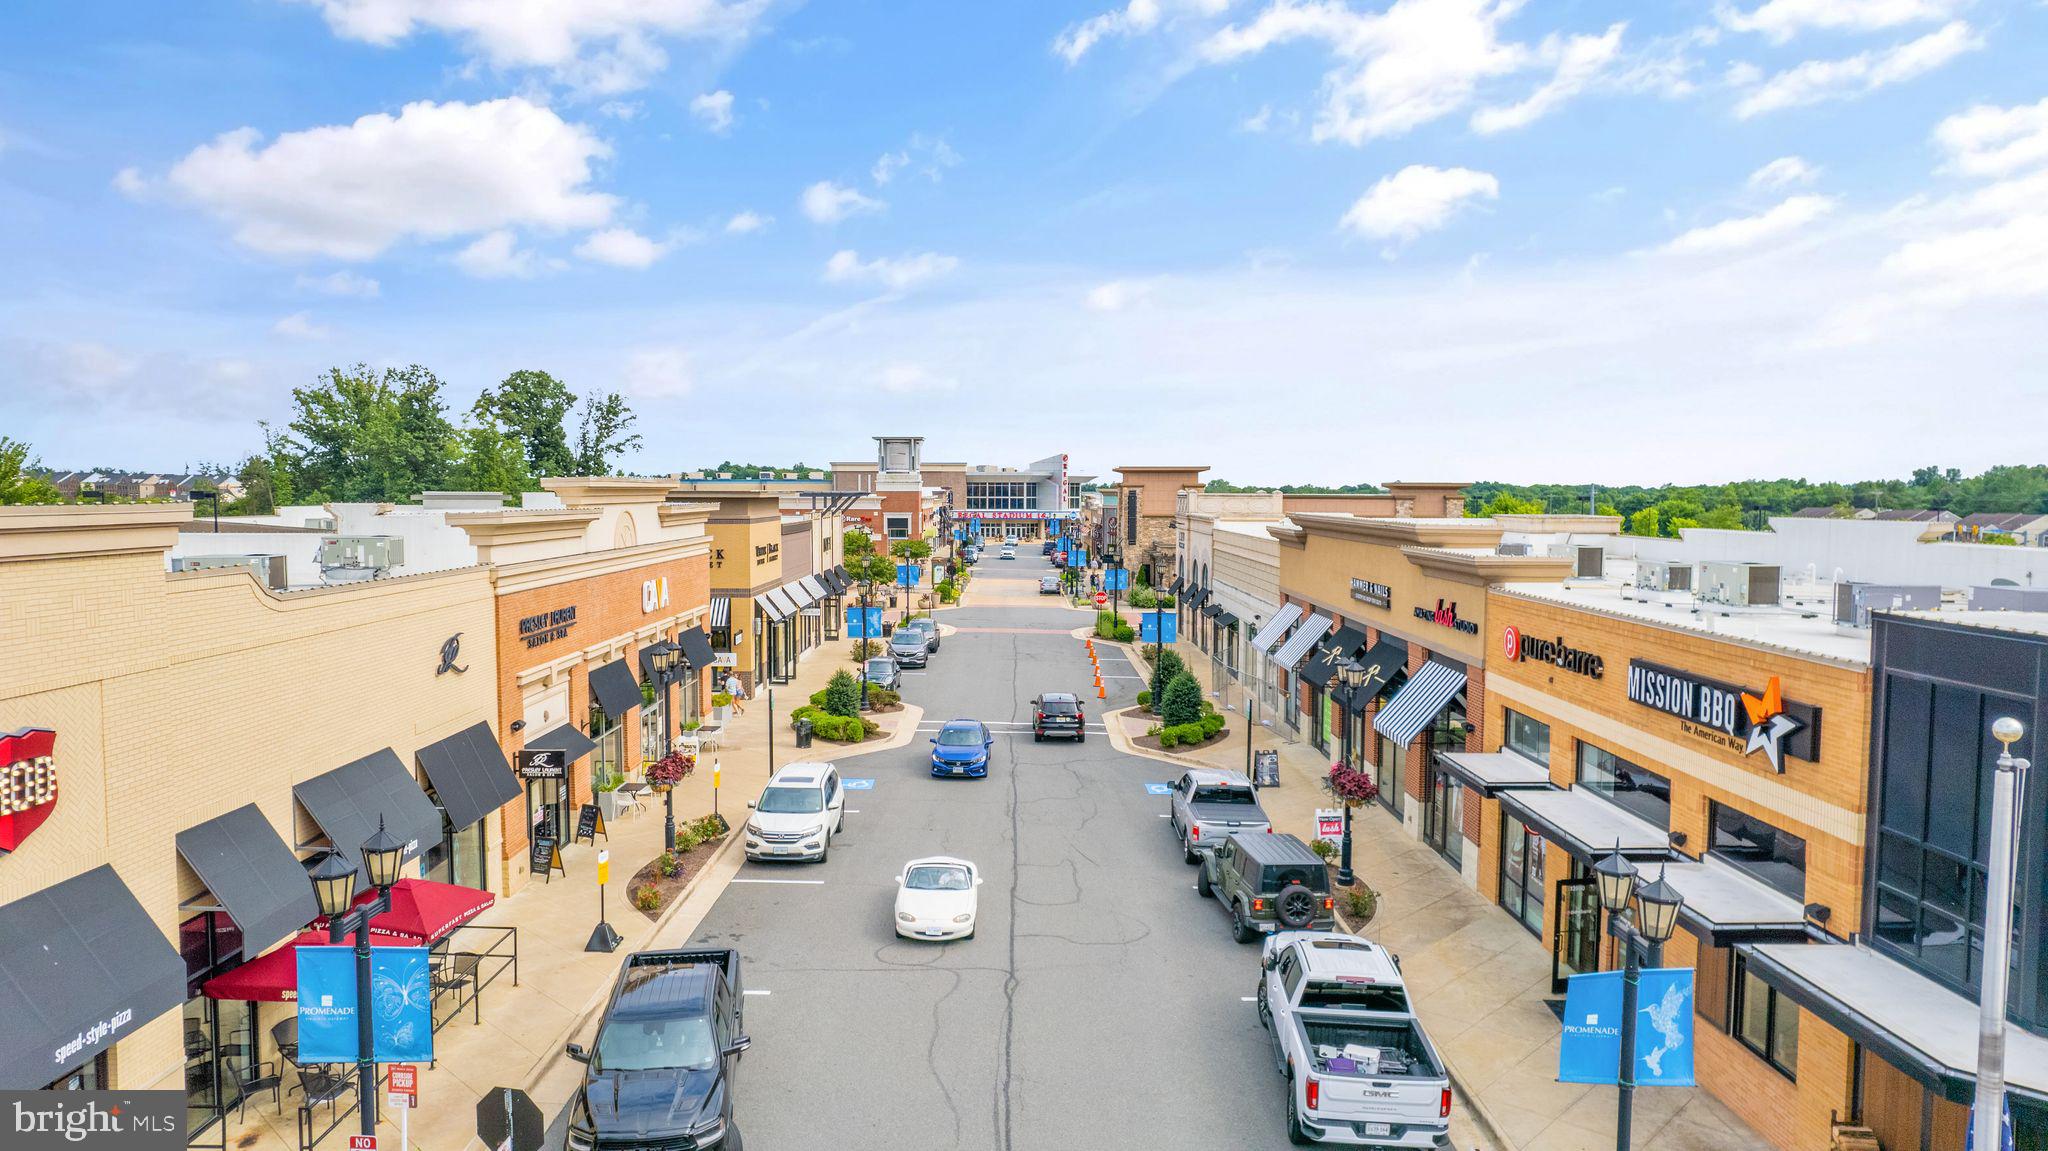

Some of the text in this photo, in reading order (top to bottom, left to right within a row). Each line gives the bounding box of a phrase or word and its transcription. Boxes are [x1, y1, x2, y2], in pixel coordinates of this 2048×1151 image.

[641, 576, 670, 614] CAVA
[519, 612, 548, 634] PRESLEY
[527, 633, 549, 649] SALON
[557, 627, 568, 639] SPA
[1627, 665, 1736, 737] MISSION BBQ
[1680, 720, 1744, 753] The American Way
[370, 927, 391, 935] PIZZA
[431, 914, 463, 940] SUPERFAST
[463, 907, 476, 917] PIZZA
[299, 1006, 356, 1015] PROMENADE
[1564, 1025, 1620, 1036] PROMENADE
[392, 1079, 413, 1087] PICKUP
[1363, 1089, 1400, 1098] GMC
[355, 1137, 371, 1149] NO
